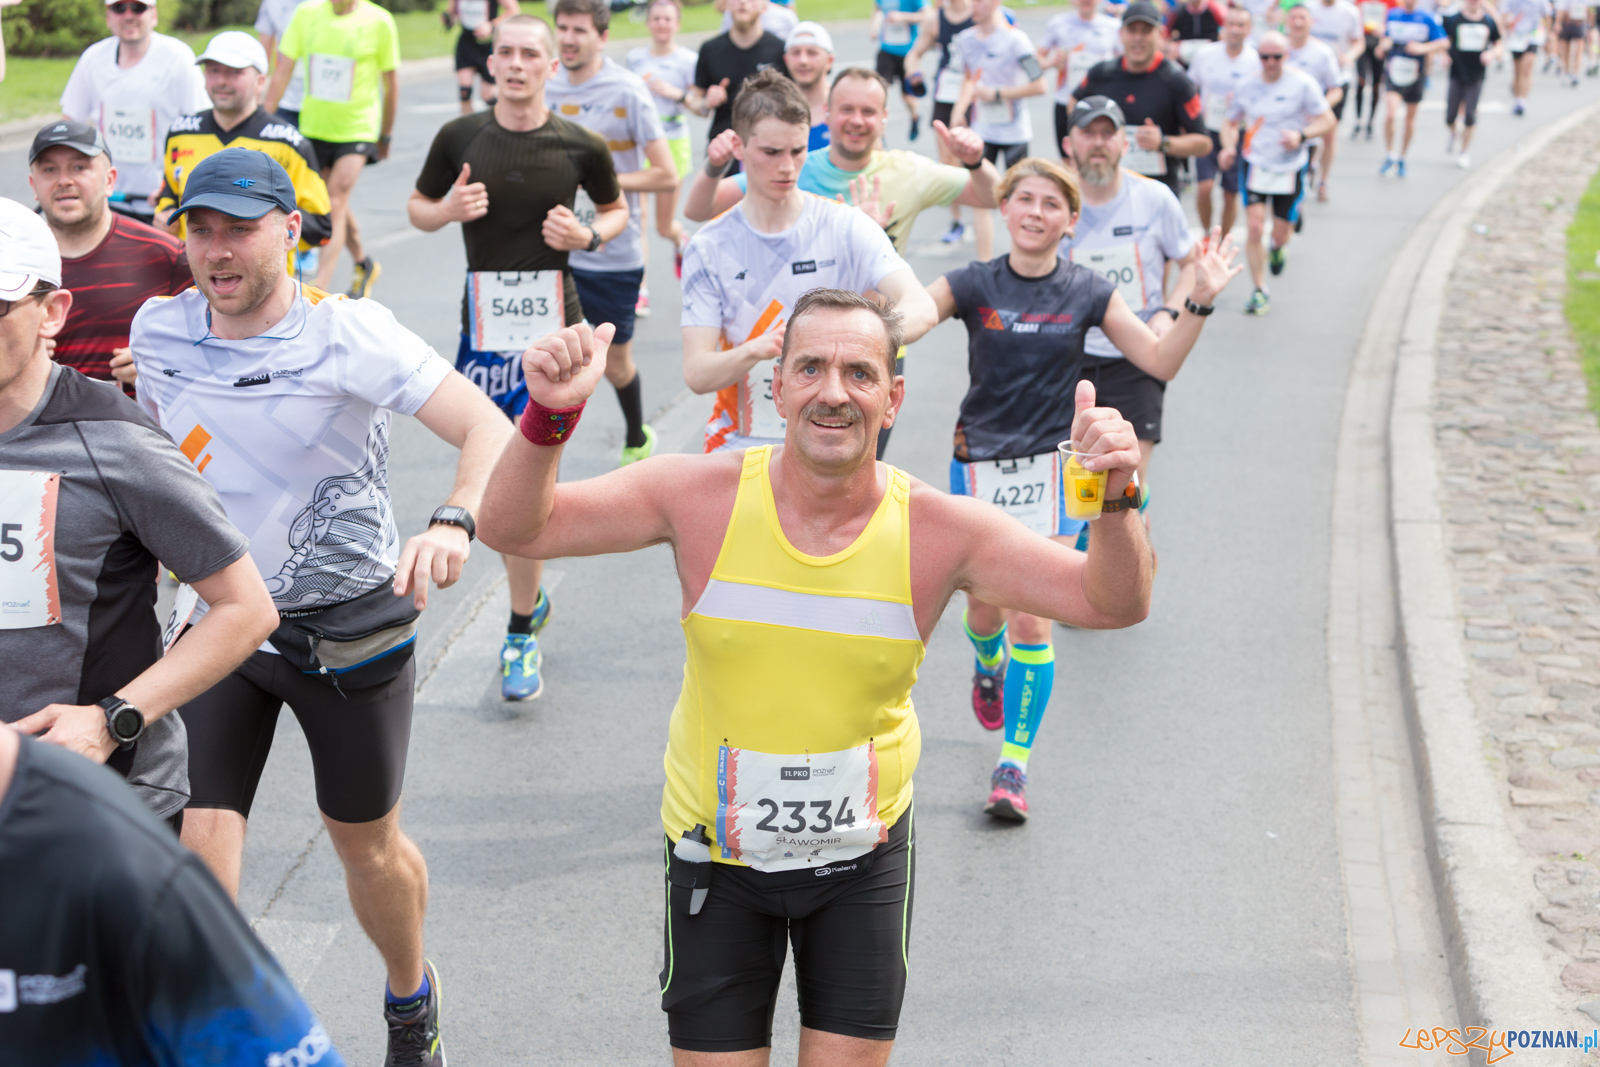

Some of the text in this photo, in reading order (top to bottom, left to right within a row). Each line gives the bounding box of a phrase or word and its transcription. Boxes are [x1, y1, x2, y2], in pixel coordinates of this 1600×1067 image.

[109, 122, 145, 140] 4105
[259, 123, 304, 147] ABAX
[492, 297, 549, 317] 5483
[1012, 321, 1039, 333] TEAM
[1021, 312, 1073, 324] TRIATHLON
[993, 482, 1045, 507] 4227
[0, 523, 24, 562] 5
[756, 796, 855, 833] 2334
[776, 836, 842, 846] SŁAWOMIR
[831, 863, 858, 874] Kalenji
